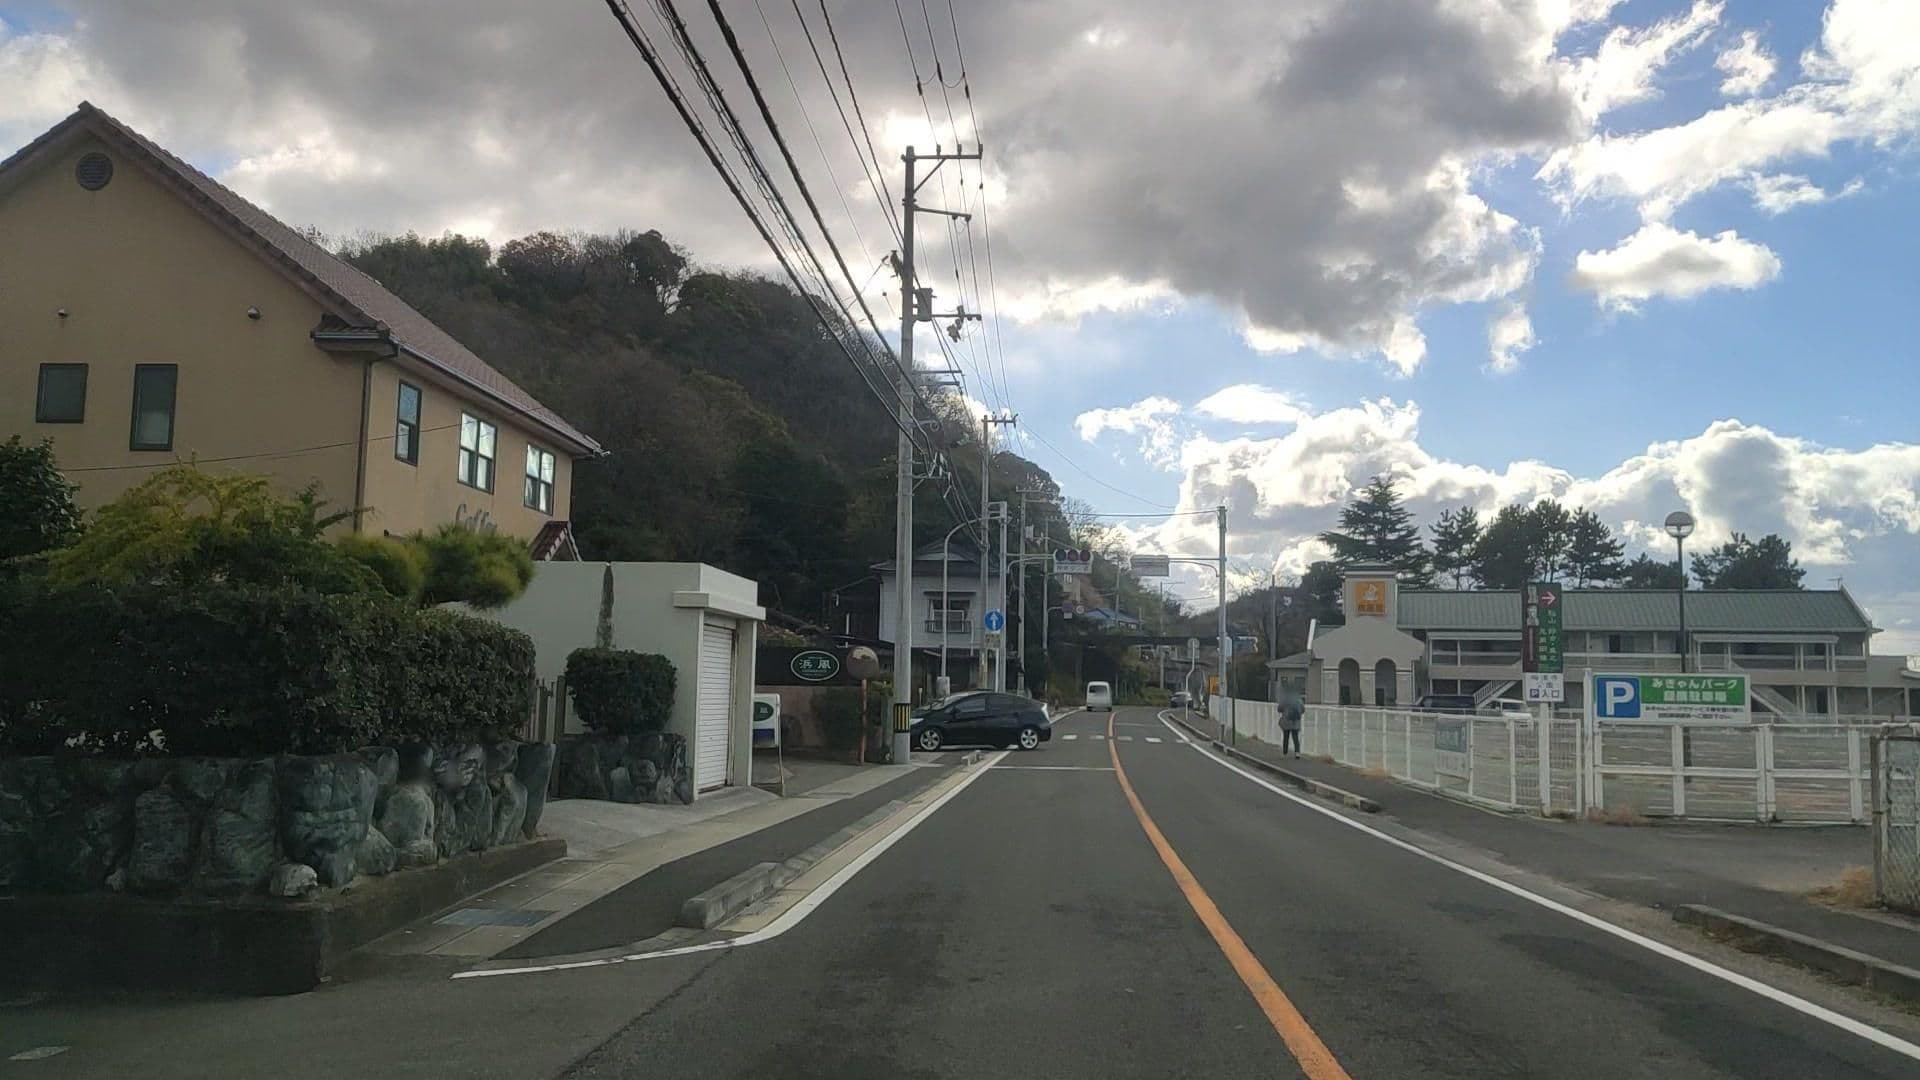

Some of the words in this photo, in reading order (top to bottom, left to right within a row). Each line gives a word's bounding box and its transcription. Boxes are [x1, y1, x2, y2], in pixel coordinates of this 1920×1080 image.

[1652, 678, 1738, 690] みきゃんパーク
[1541, 689, 1559, 698] 入口
[1605, 680, 1635, 716] P
